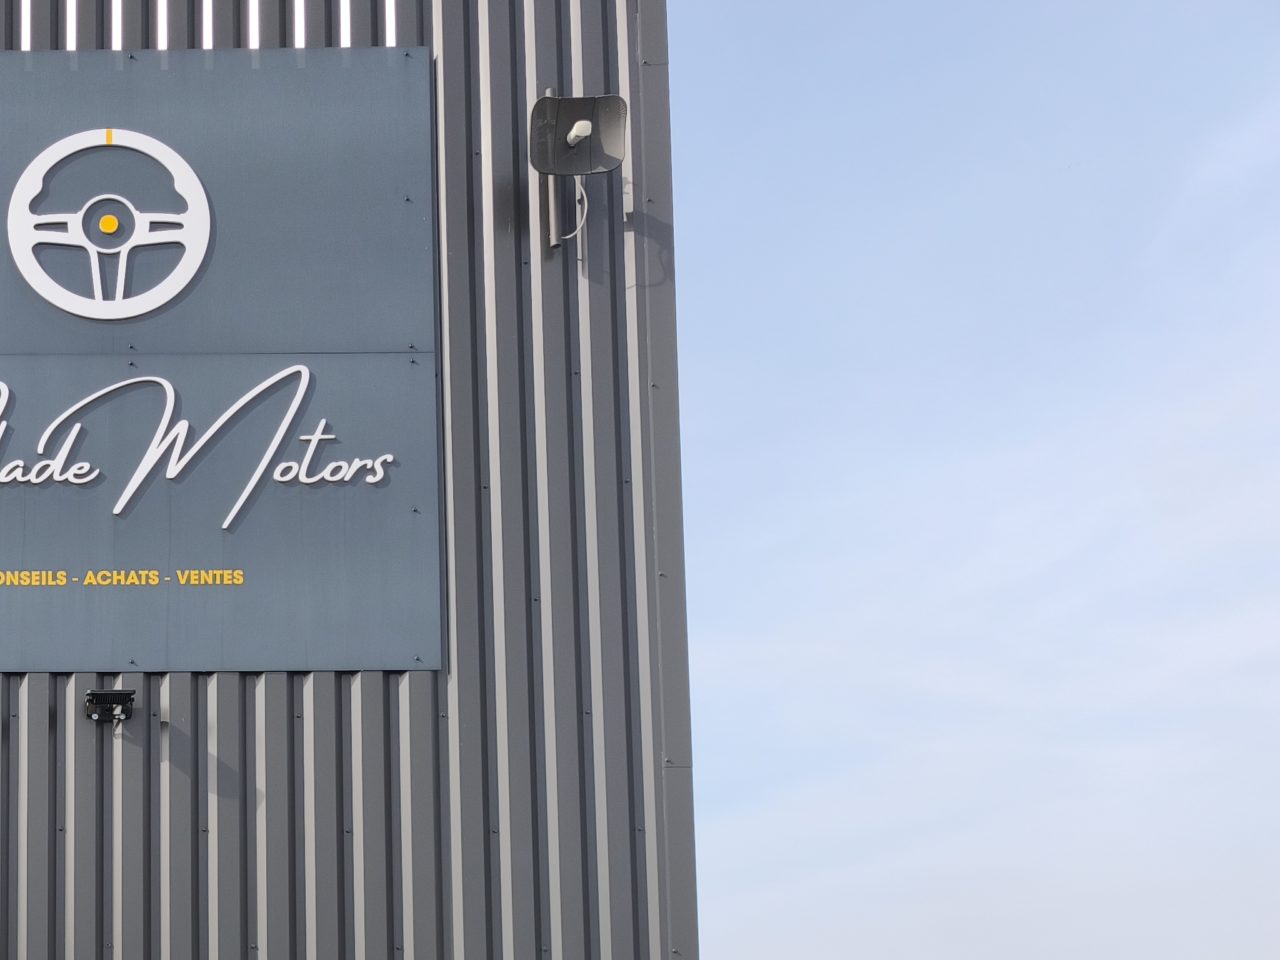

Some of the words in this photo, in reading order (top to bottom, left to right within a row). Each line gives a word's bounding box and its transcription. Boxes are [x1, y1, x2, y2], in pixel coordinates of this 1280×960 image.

[37, 364, 394, 530] Motors
[83, 569, 160, 586] ACHATS
[175, 569, 245, 586] VENTES
